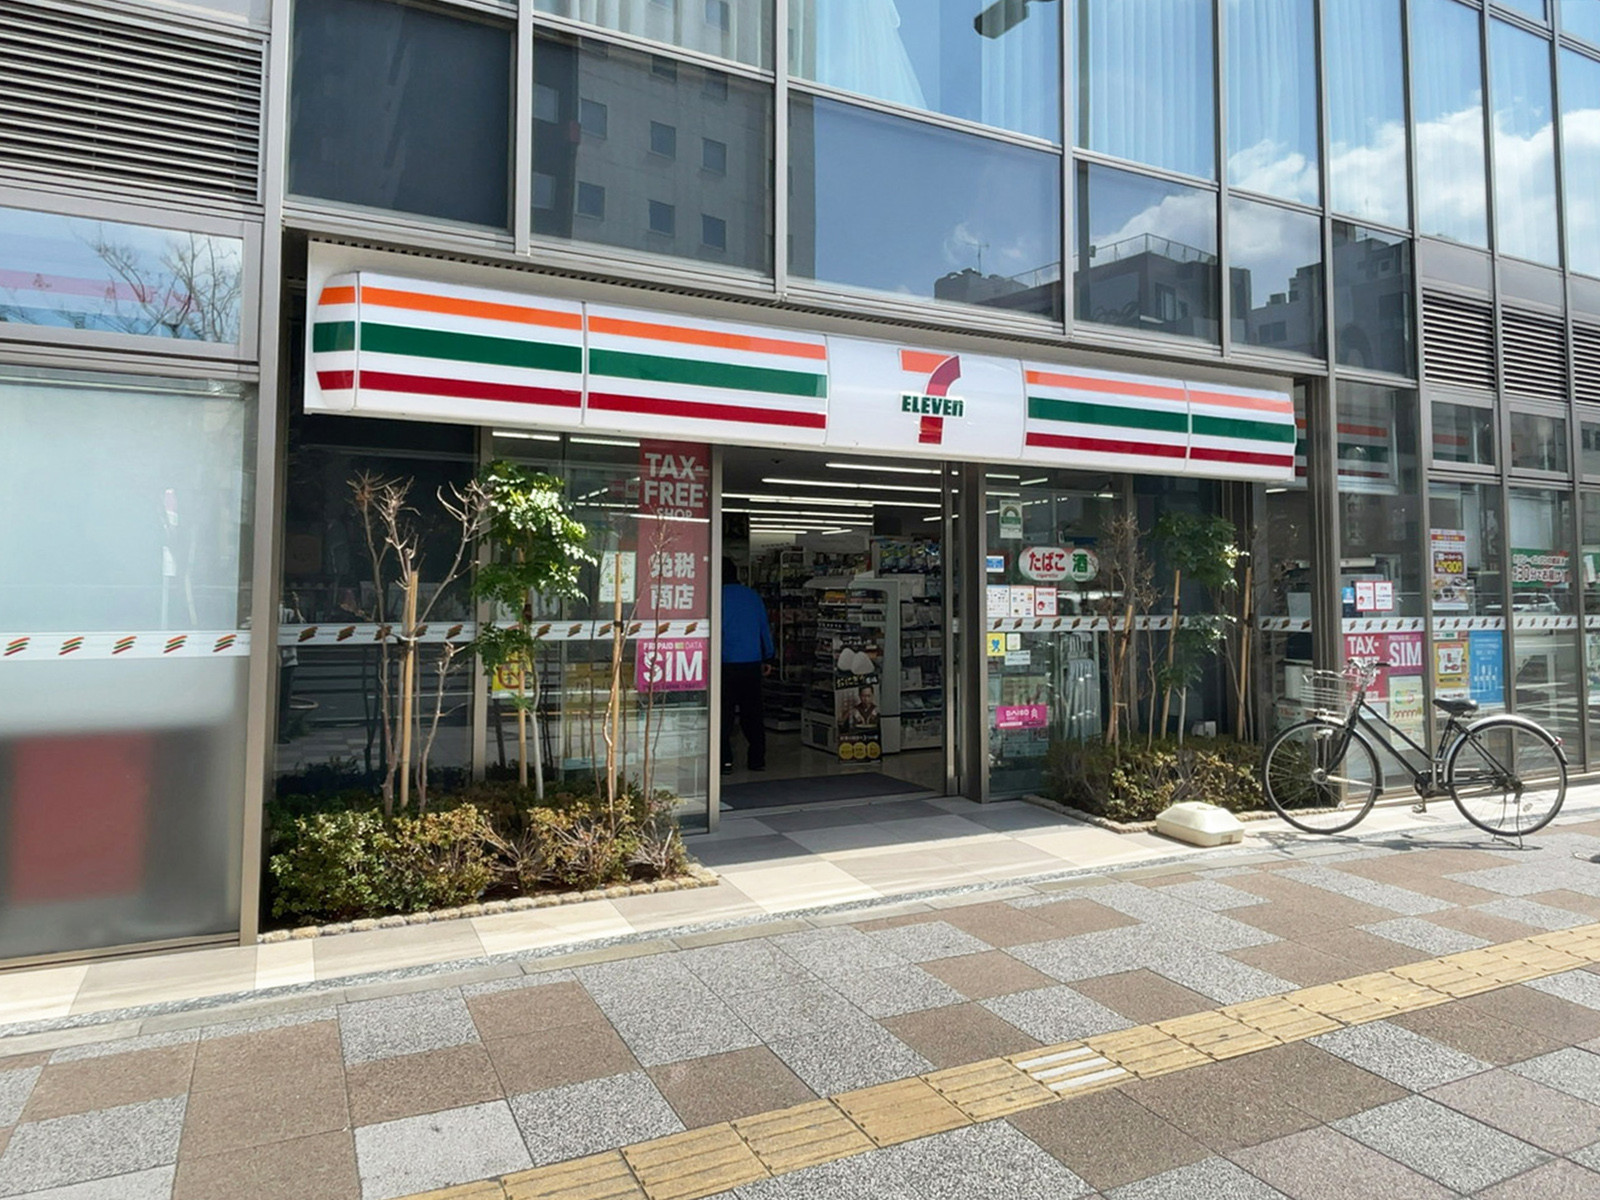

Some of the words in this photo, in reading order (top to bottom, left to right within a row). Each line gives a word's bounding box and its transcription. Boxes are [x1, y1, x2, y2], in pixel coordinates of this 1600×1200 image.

[899, 349, 961, 445] 7
[644, 452, 704, 481] TAX-
[644, 481, 704, 508] FREE
[1029, 552, 1065, 572] たばこ
[1072, 553, 1088, 573] 酒
[1347, 636, 1380, 655] TAX-
[1389, 641, 1422, 667] SIM
[643, 651, 703, 683] SIM
